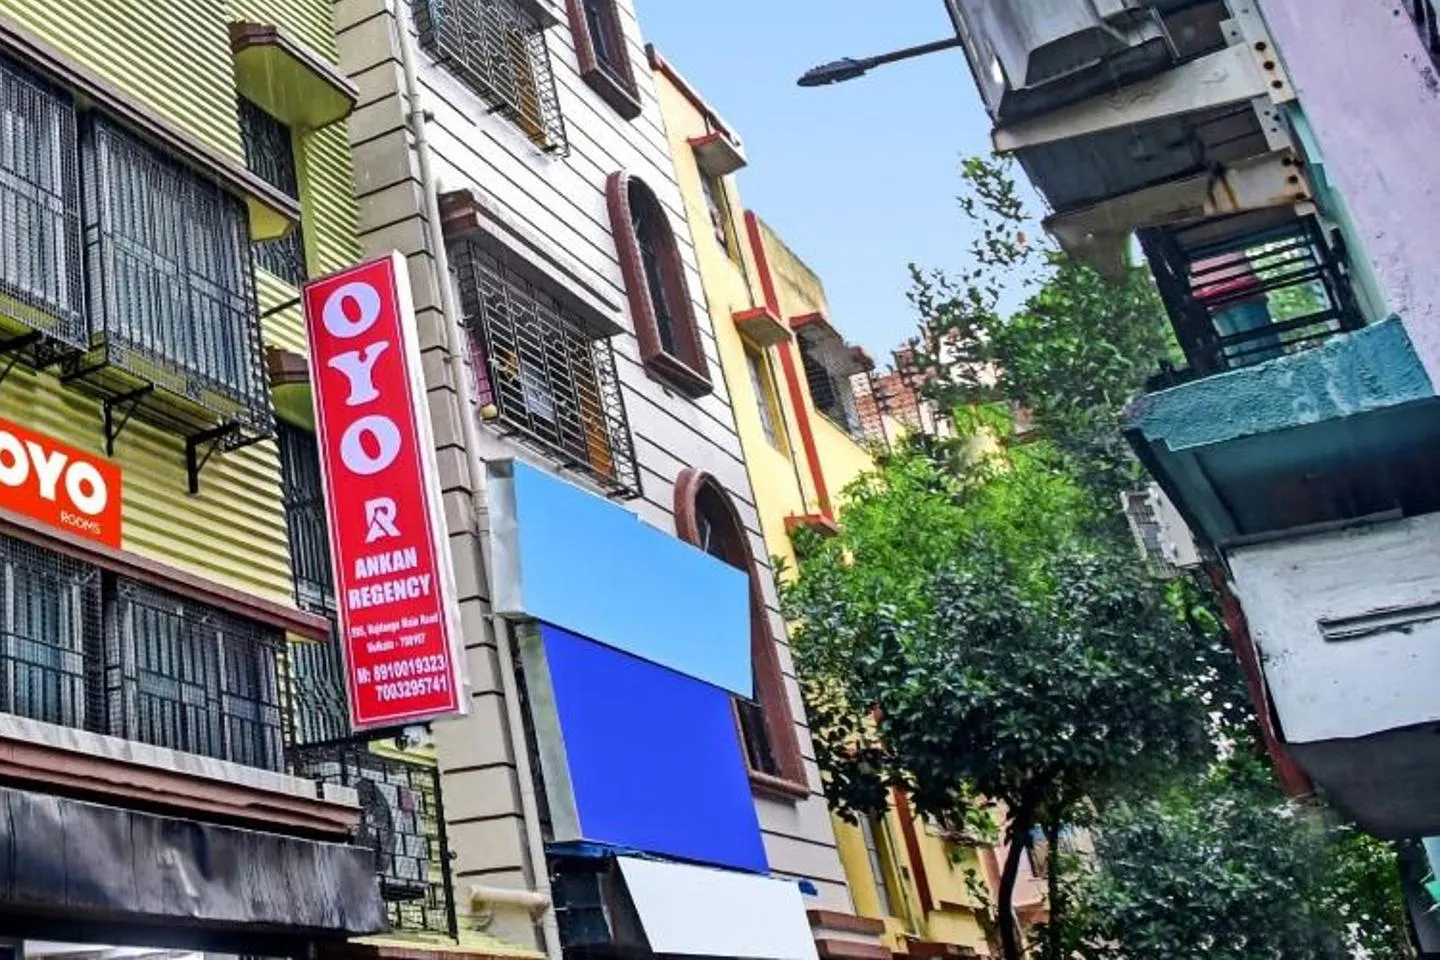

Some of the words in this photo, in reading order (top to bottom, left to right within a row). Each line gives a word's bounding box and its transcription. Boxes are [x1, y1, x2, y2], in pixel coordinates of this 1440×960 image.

[323, 282, 402, 475] OYO
[60, 511, 101, 534] ROOMS
[355, 547, 417, 580] ANKAN
[348, 574, 431, 609] REGENCY
